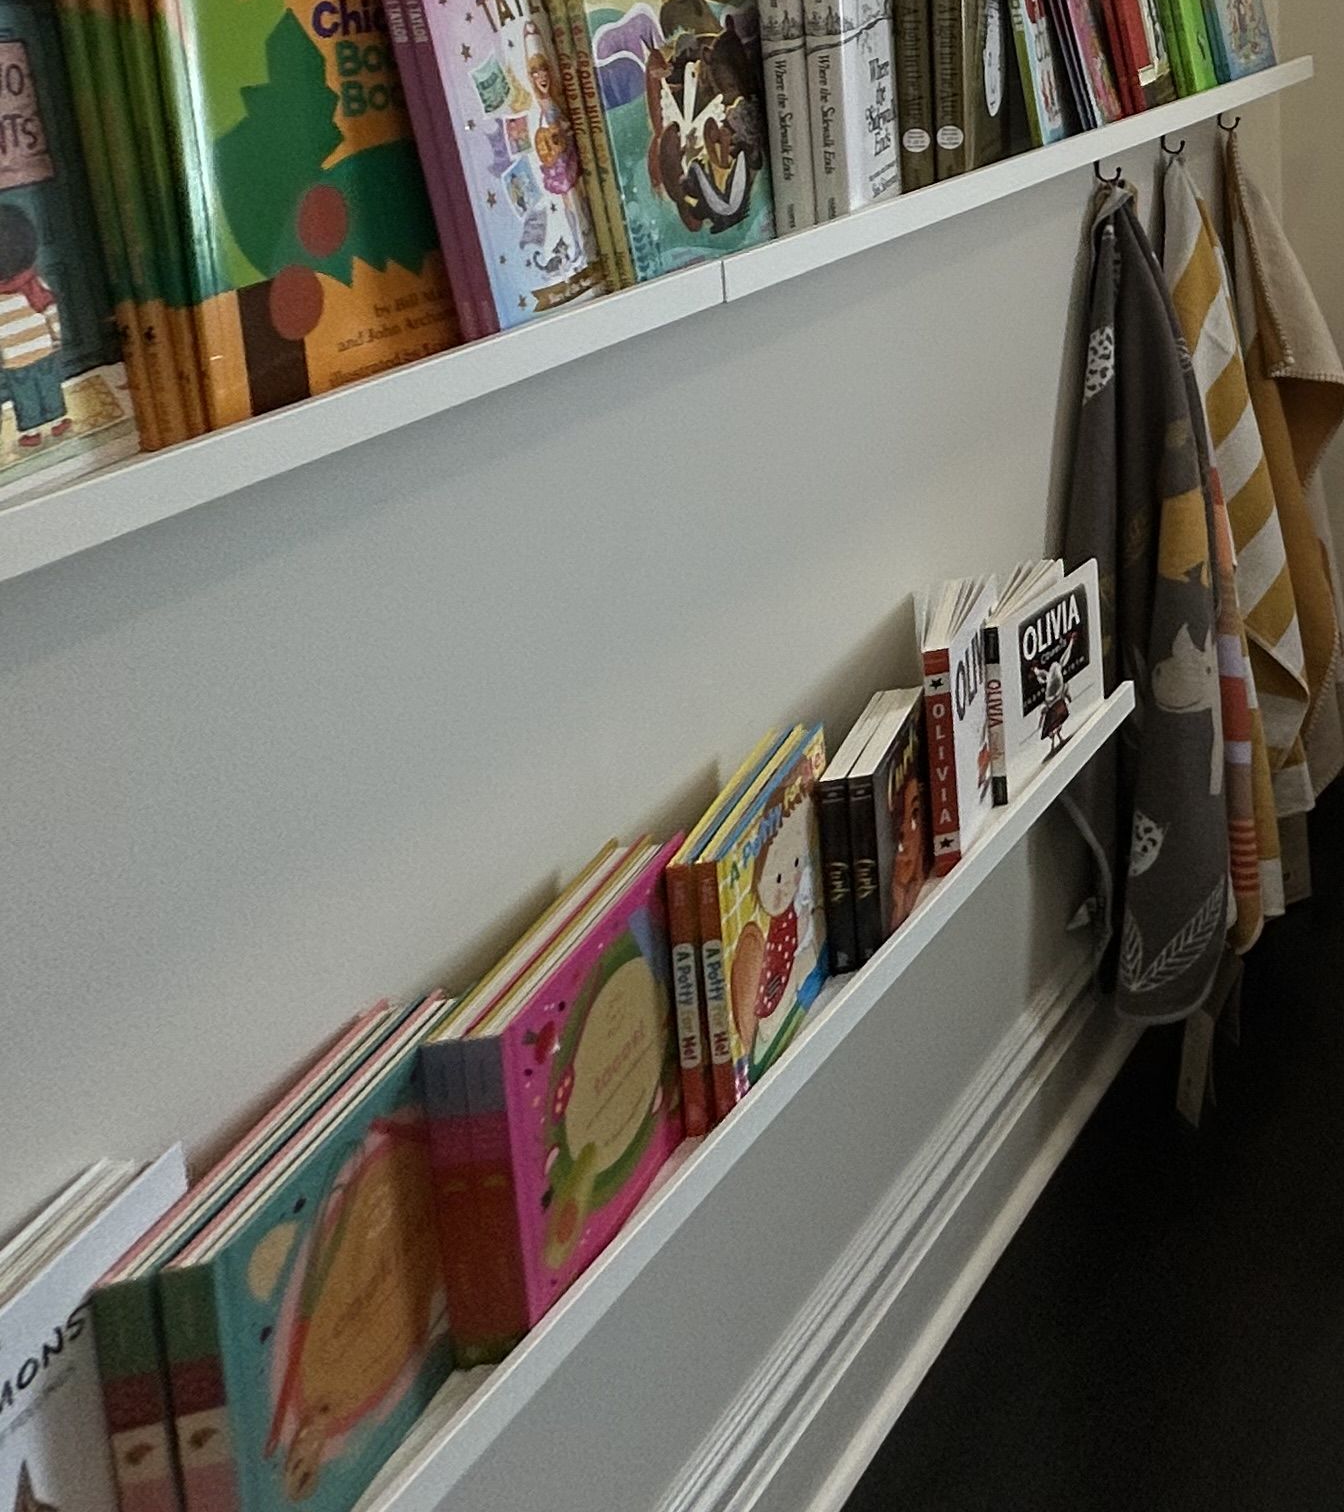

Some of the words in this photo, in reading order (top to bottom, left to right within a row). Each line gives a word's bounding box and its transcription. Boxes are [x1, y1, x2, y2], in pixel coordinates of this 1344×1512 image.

[336, 40, 390, 76] Bo
[773, 58, 787, 89] Where
[817, 53, 831, 84] Where
[577, 49, 595, 101] GROUP
[341, 81, 393, 117] Bo
[776, 91, 788, 109] the
[820, 86, 831, 104] the
[777, 110, 794, 154] Sidewalk
[820, 105, 837, 148] Sidewalk
[781, 156, 794, 181] Ends
[824, 150, 838, 175] Ends
[1022, 593, 1080, 661] OLIVIA
[987, 679, 1004, 728] OLIVIA
[931, 703, 953, 826] OLIVIA
[677, 951, 689, 962] A
[706, 948, 719, 958] A
[677, 967, 694, 1005] Potty
[707, 961, 725, 1001] Potty
[682, 1035, 696, 1060] Me!
[713, 1031, 729, 1057] Me!
